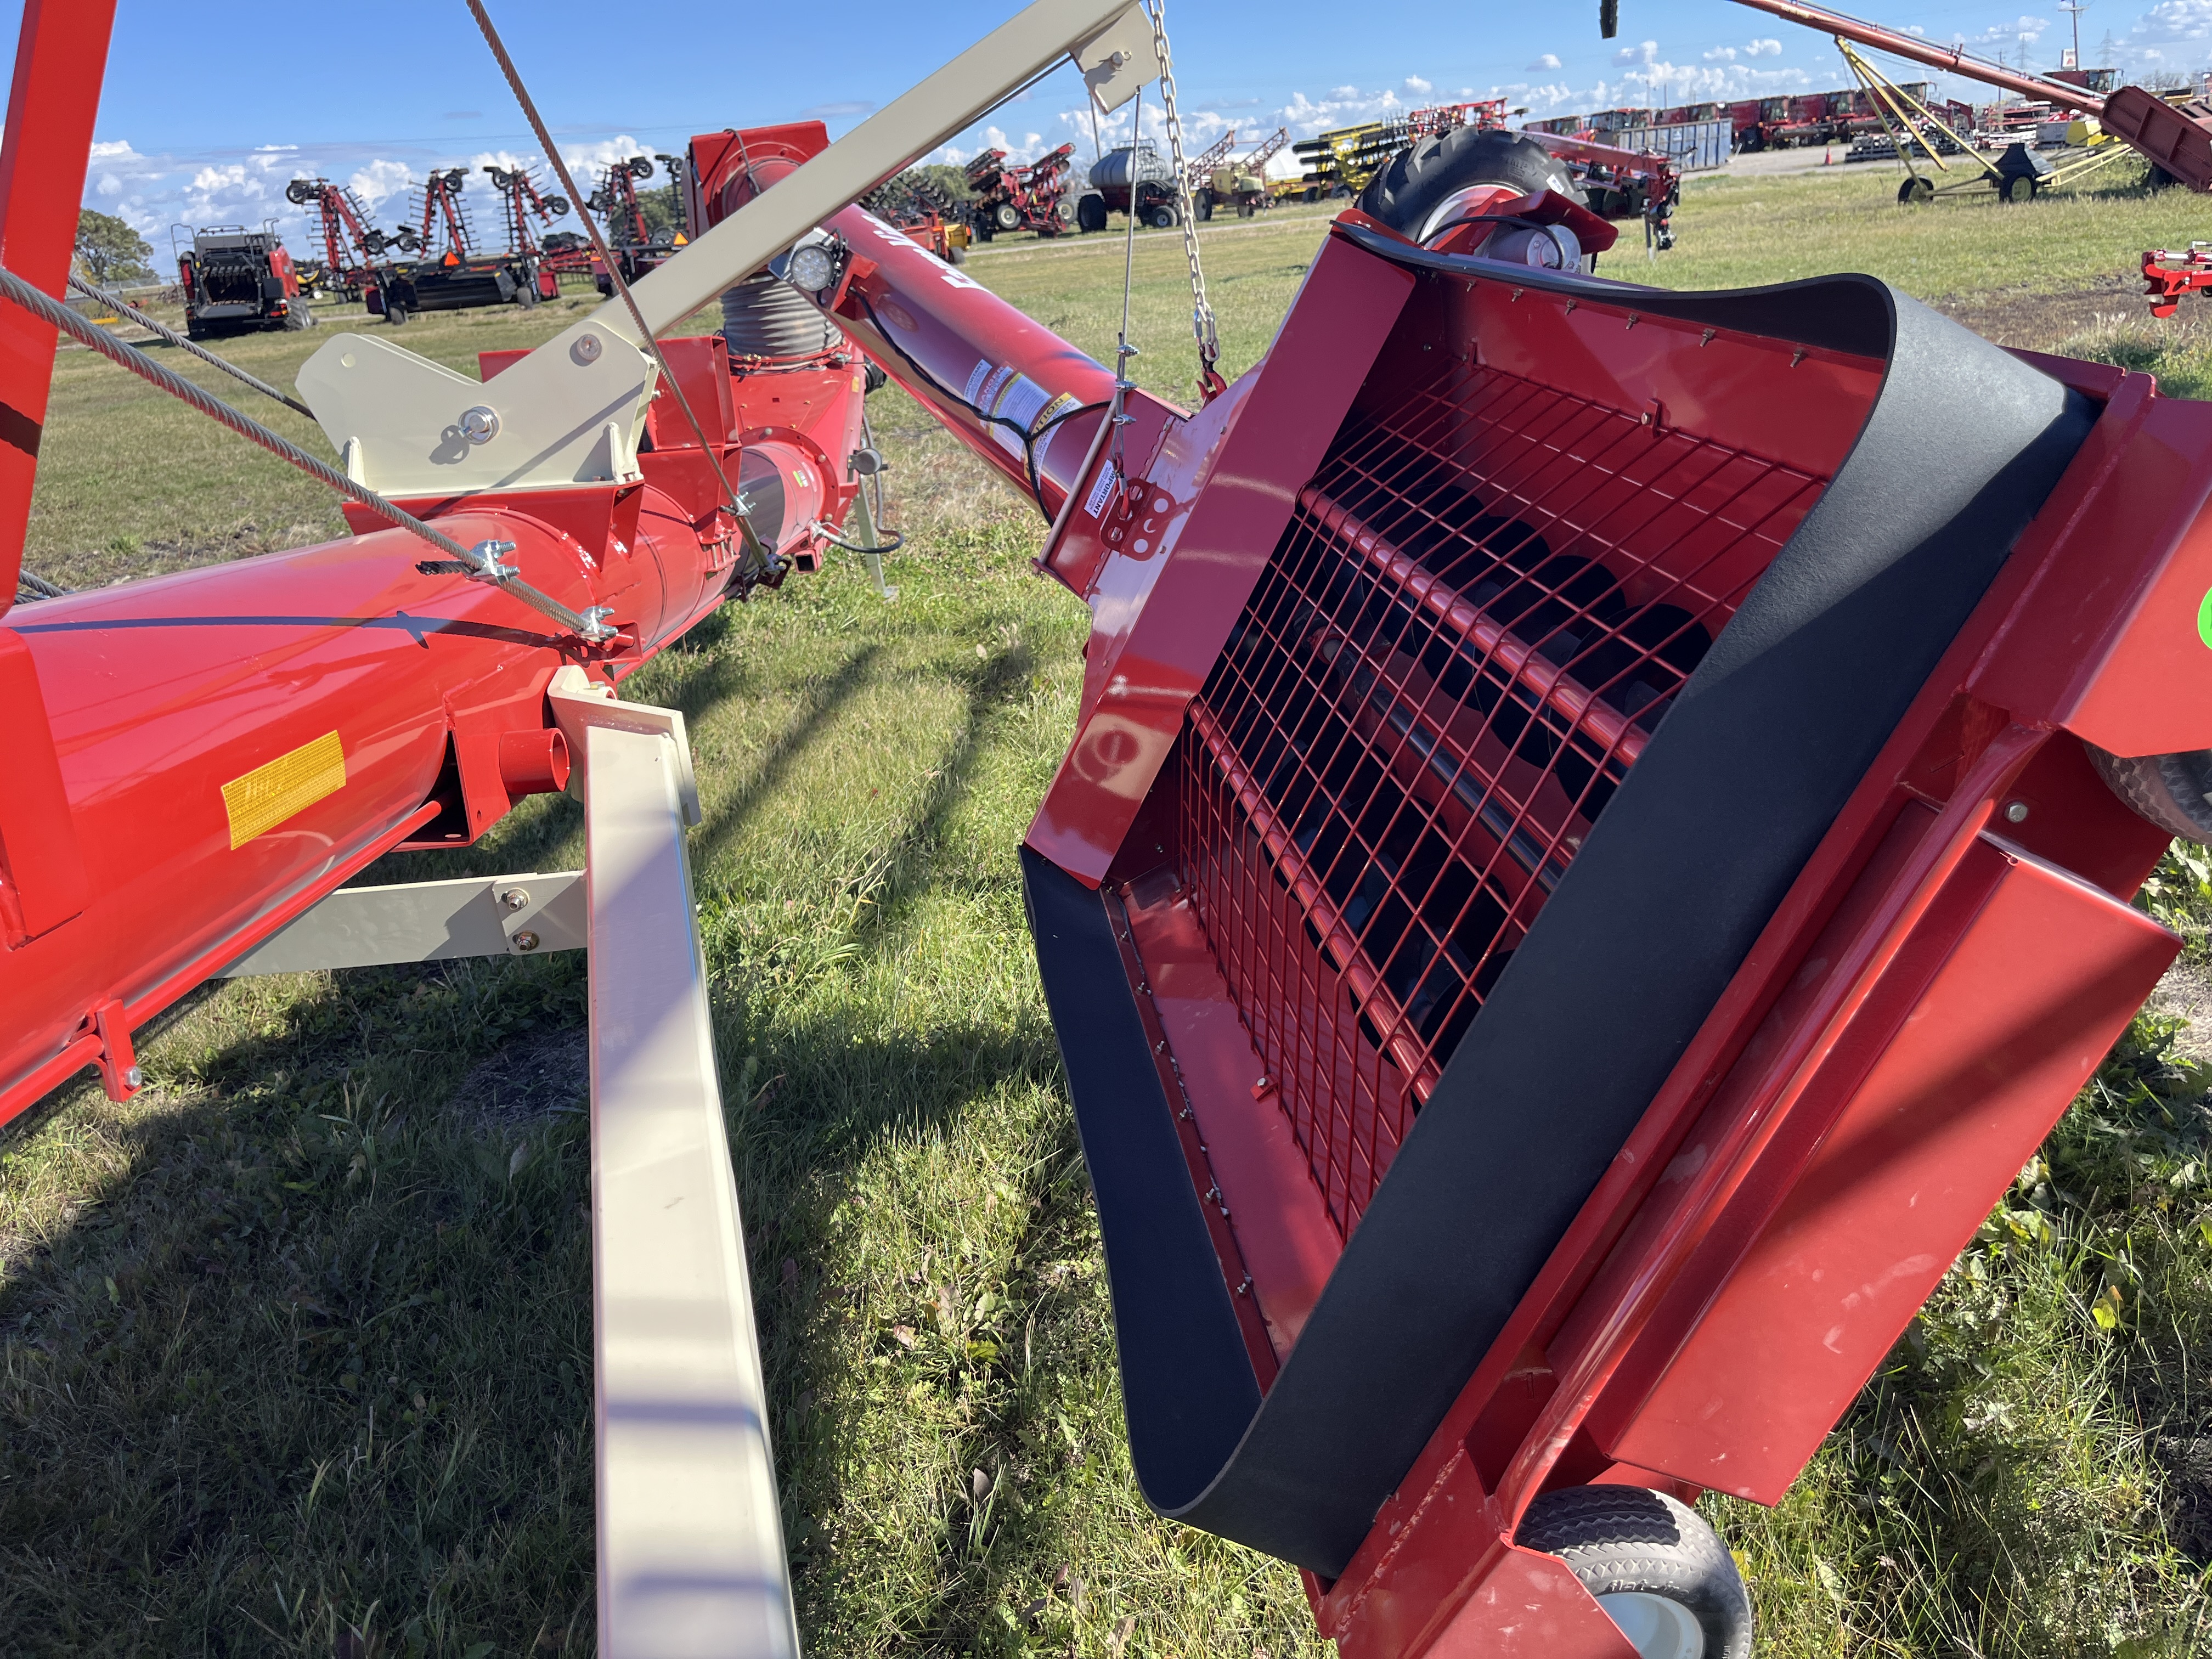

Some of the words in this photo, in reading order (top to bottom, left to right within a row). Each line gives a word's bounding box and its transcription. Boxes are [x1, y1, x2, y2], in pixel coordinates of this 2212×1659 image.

[979, 366, 1005, 409] DANGER
[1033, 398, 1064, 434] UTION
[1093, 471, 1116, 515] MPORTANT
